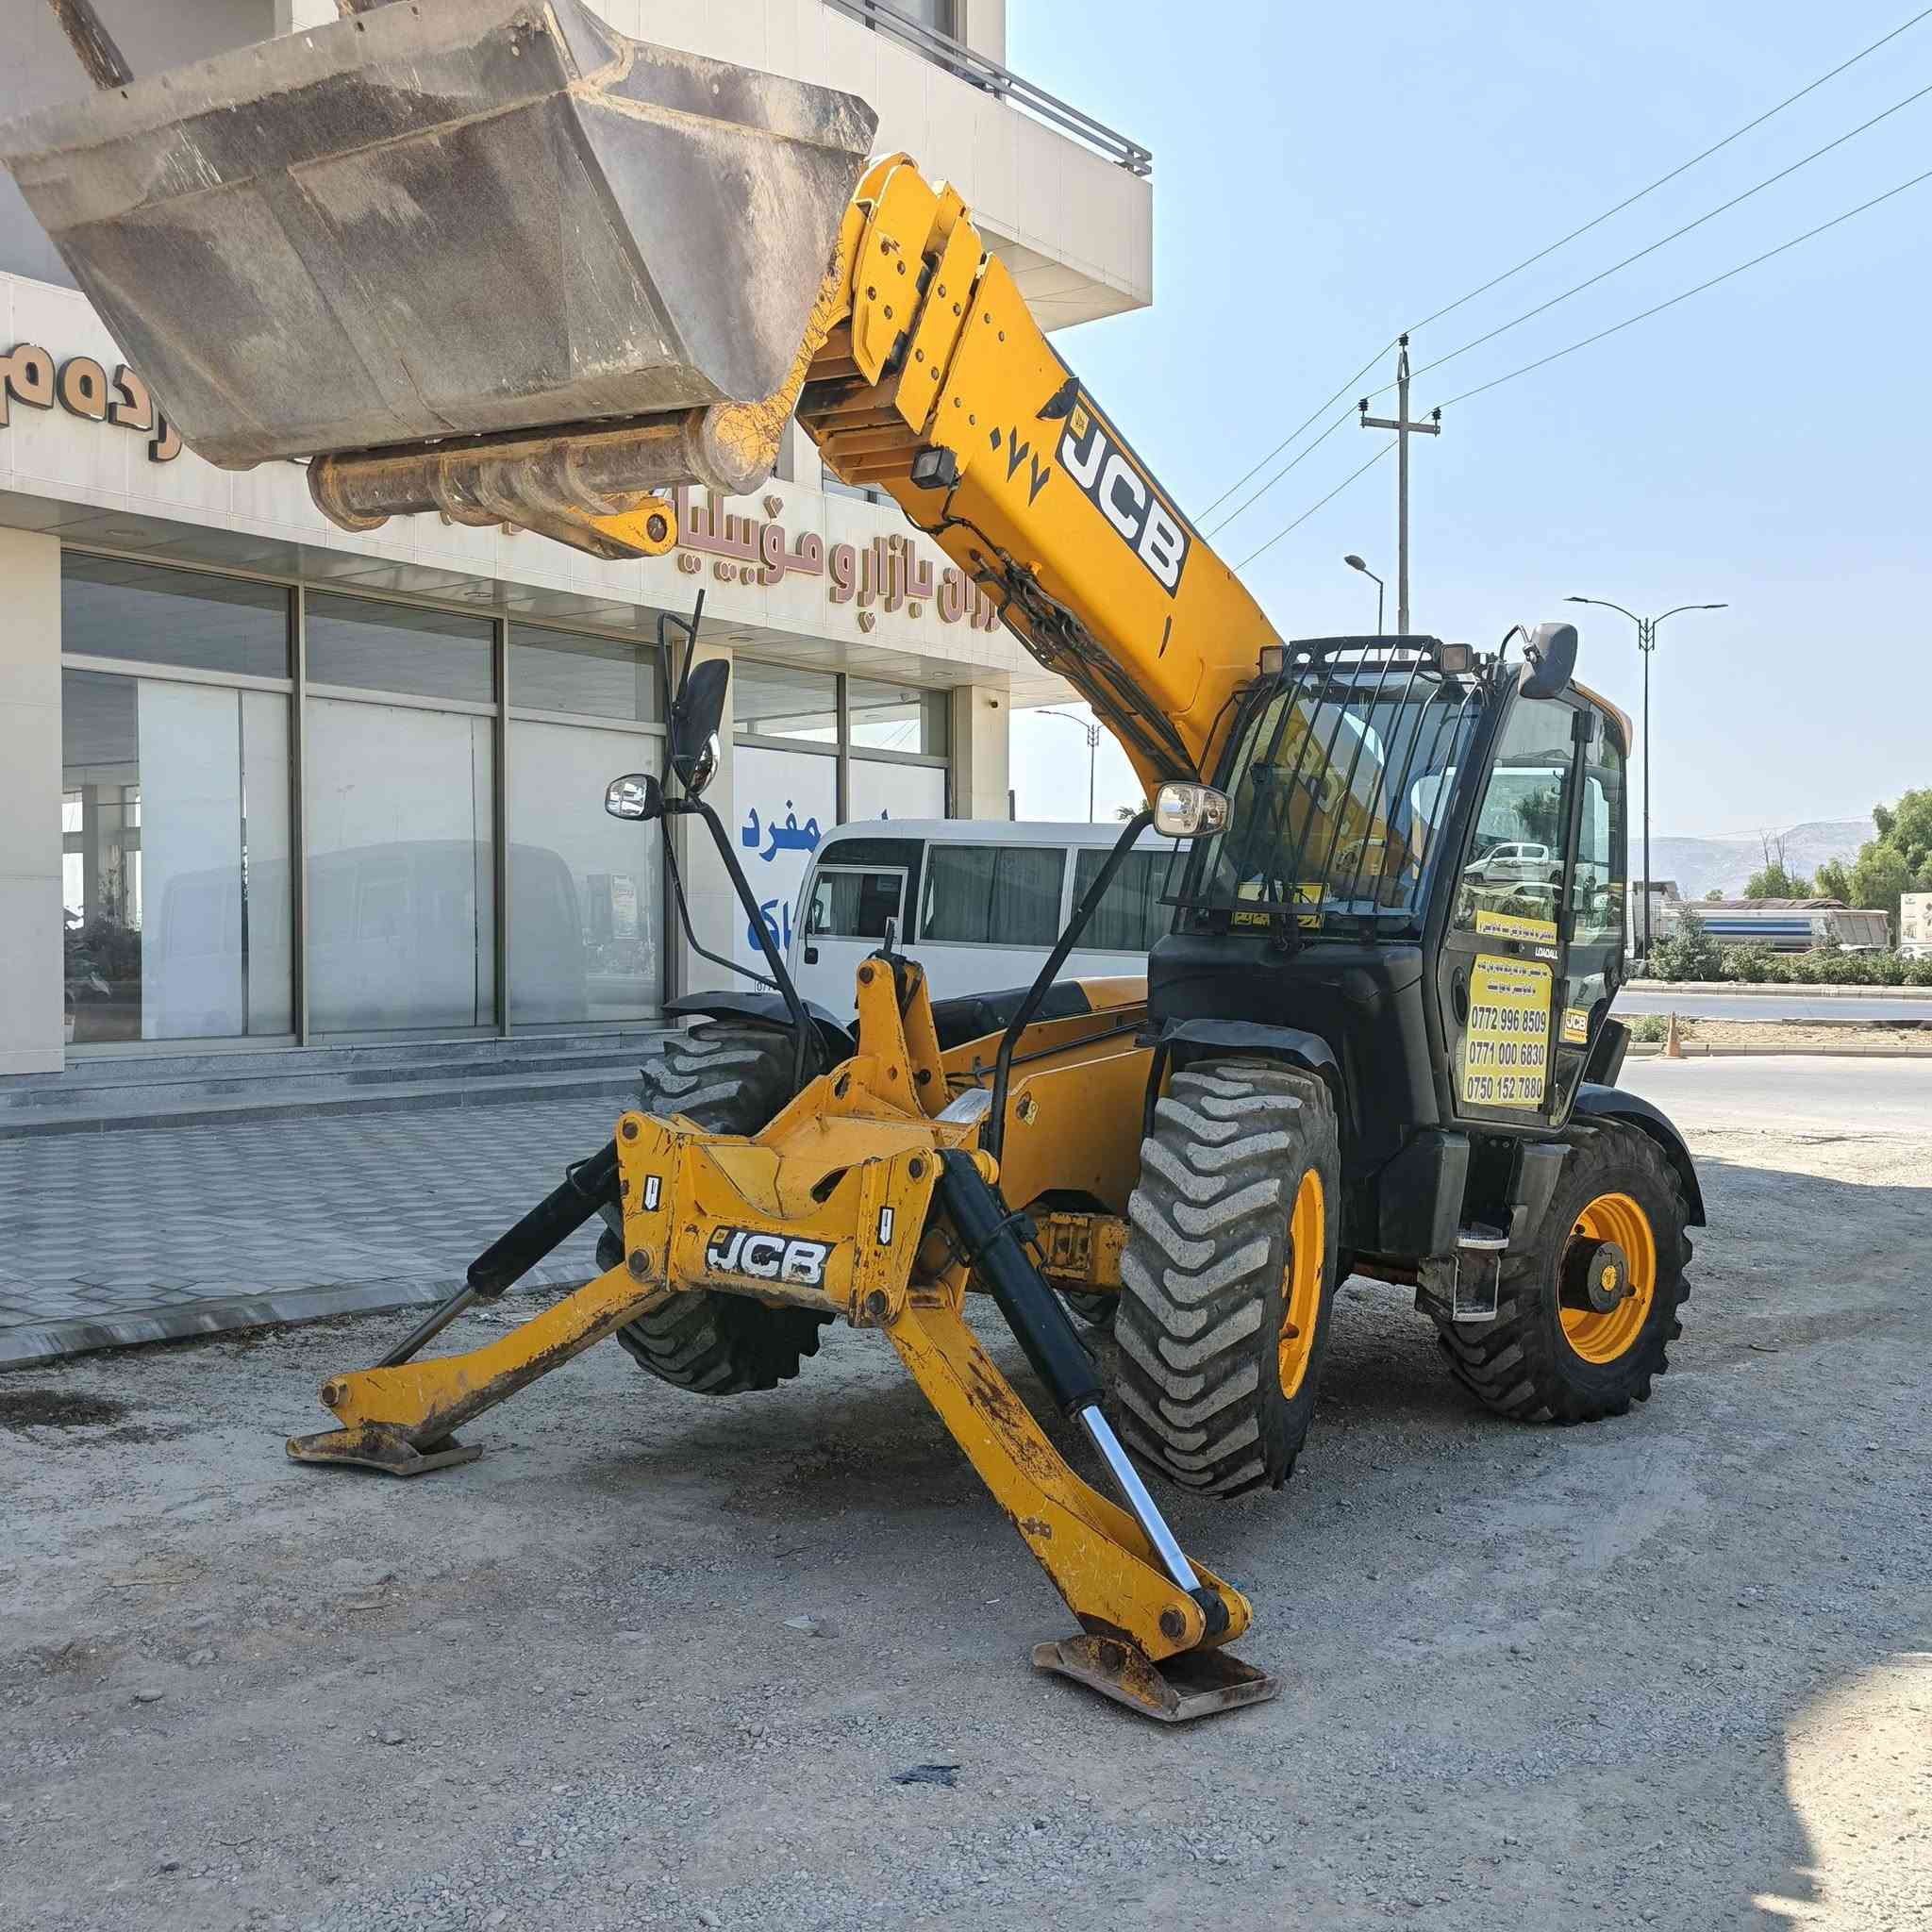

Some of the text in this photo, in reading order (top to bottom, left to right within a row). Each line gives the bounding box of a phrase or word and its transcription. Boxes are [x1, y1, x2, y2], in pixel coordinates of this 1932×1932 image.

[1062, 428, 1185, 588] JCB
[1472, 1006, 1546, 1033] 0772 996 8509
[1566, 1013, 1586, 1031] JCB
[1469, 1041, 1544, 1066] 0771 000 6830
[1467, 1076, 1542, 1100] 0750 152 7880
[708, 1232, 827, 1284] JCB
